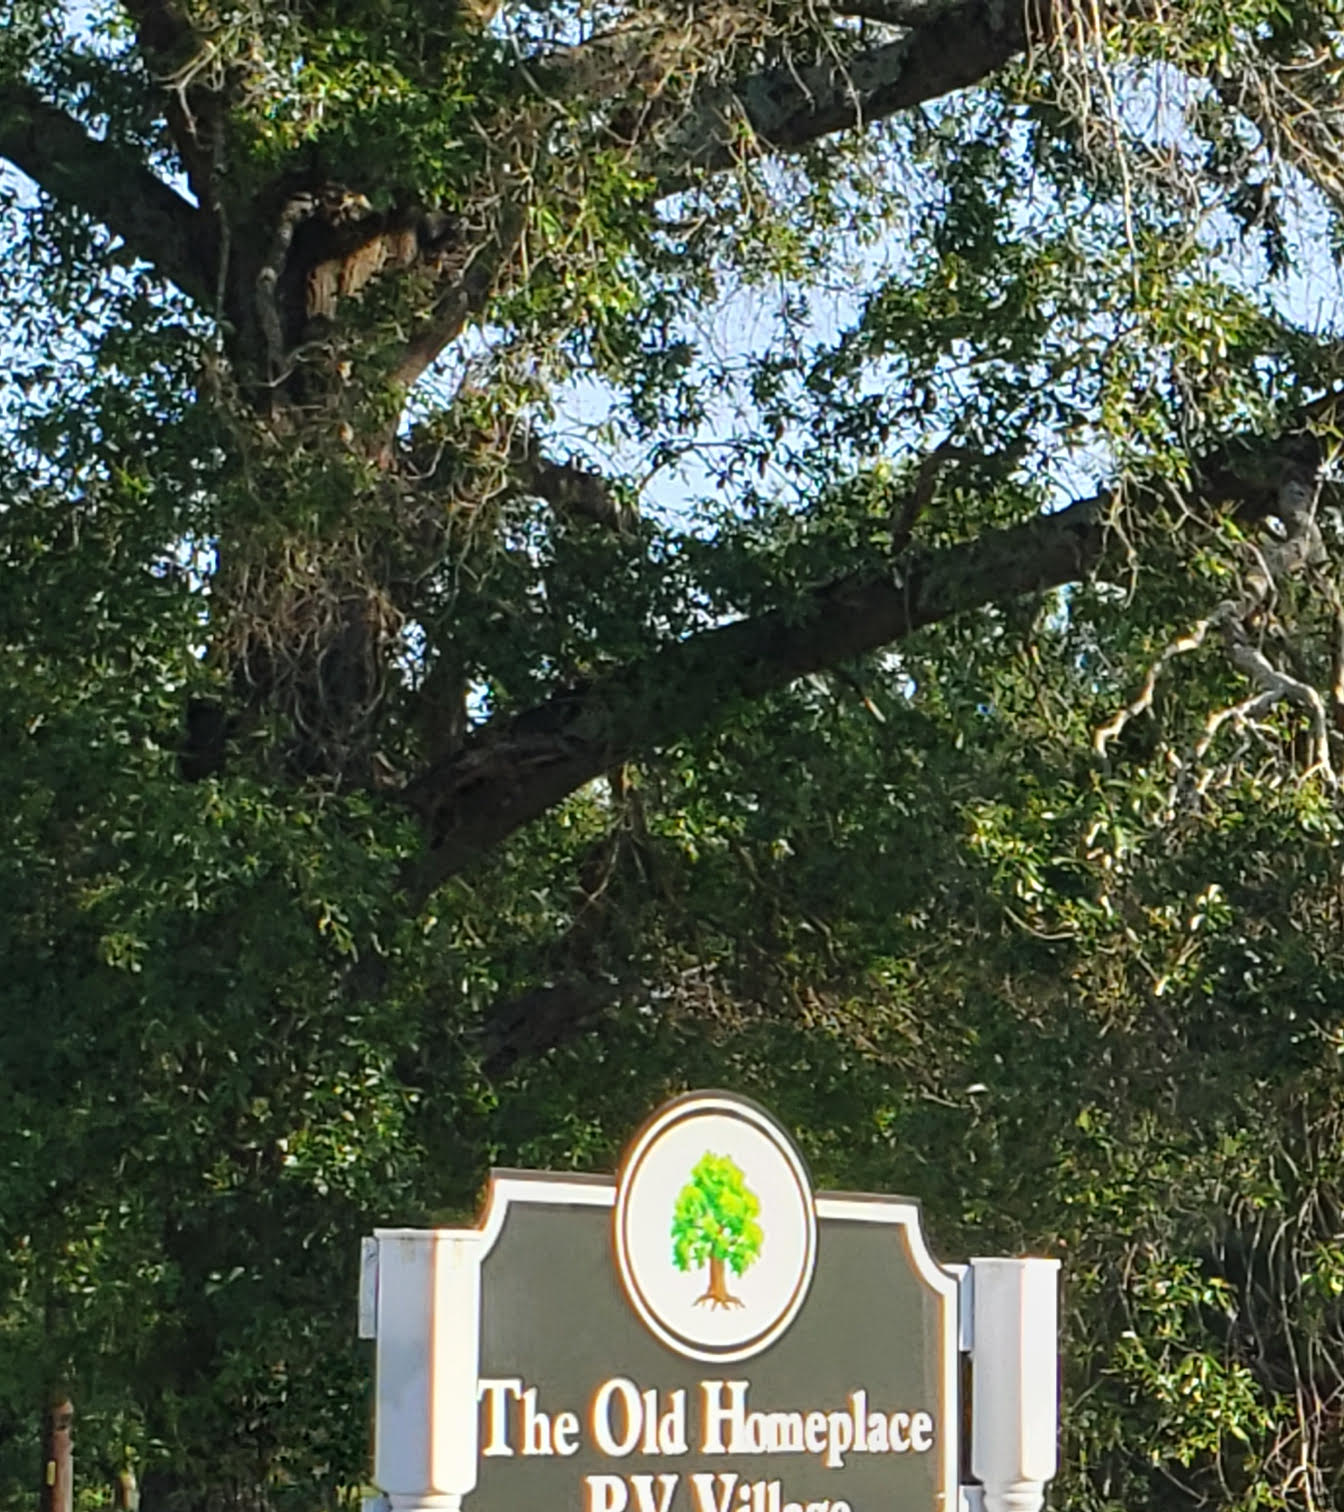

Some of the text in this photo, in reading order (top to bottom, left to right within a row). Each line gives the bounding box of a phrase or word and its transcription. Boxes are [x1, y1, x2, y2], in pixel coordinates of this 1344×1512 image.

[479, 1377, 935, 1468] The Old Homeplace
